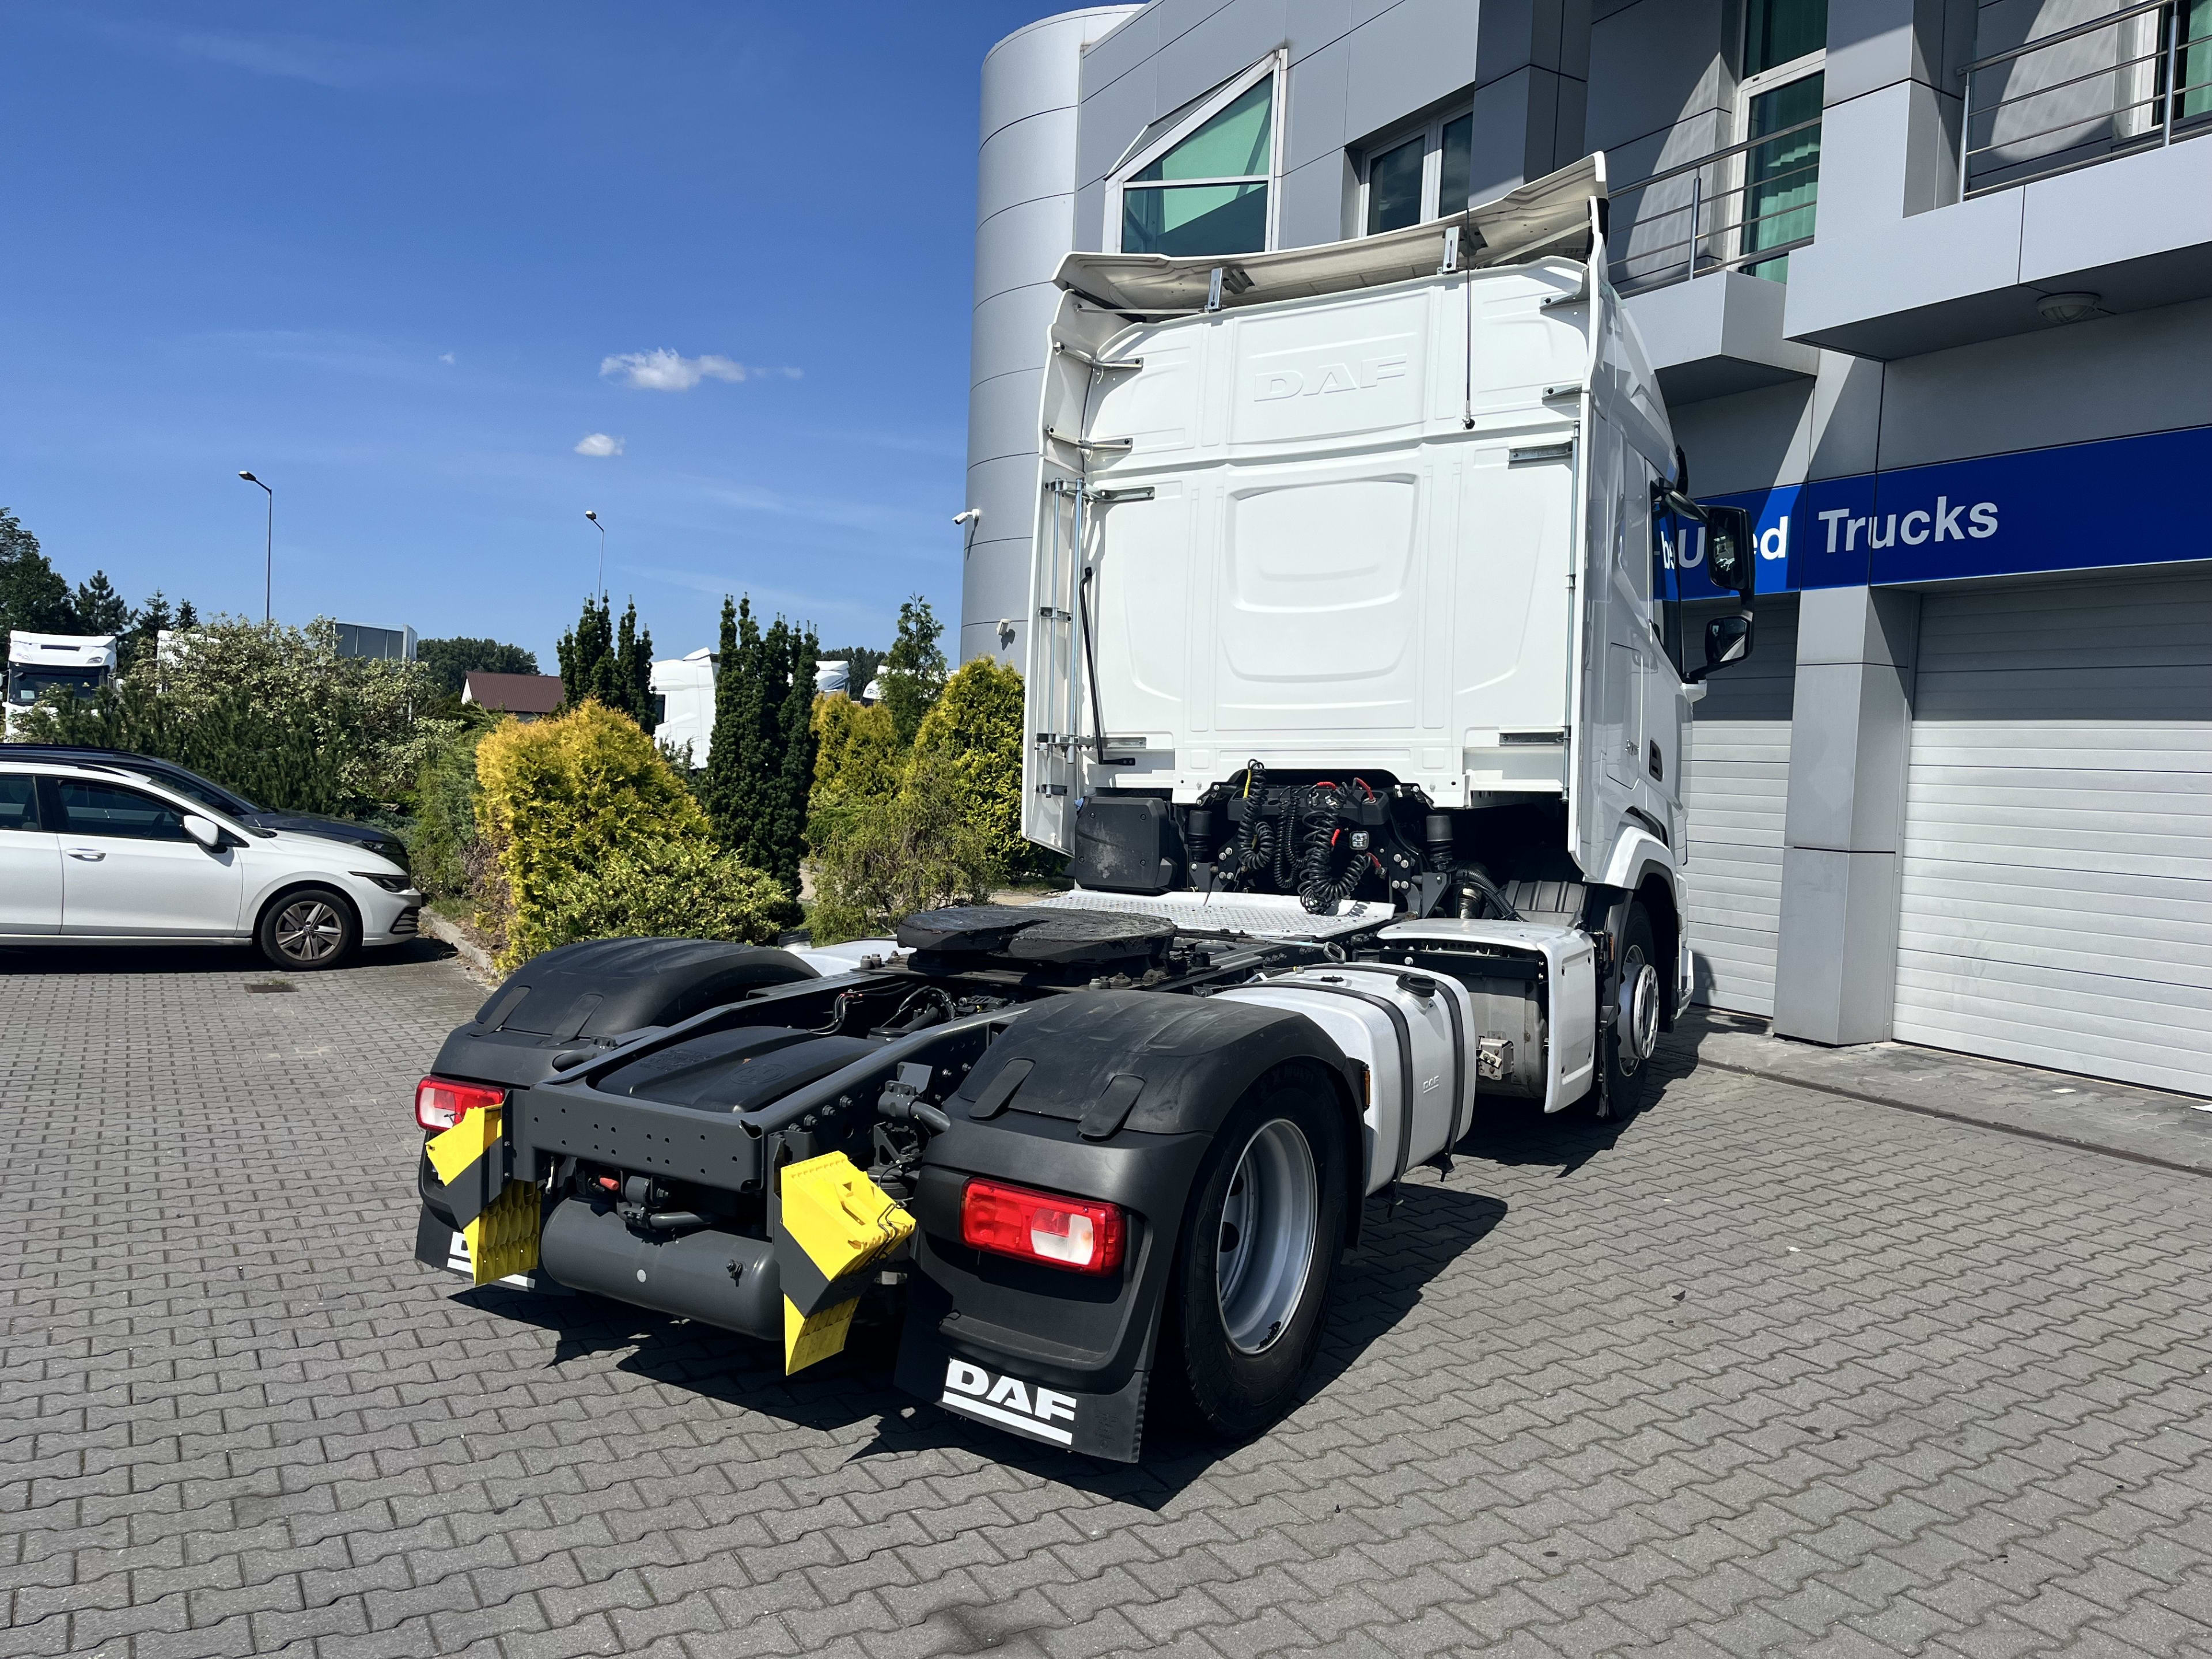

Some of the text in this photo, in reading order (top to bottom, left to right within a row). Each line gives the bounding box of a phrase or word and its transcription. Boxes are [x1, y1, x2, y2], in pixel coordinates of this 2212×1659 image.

[1254, 354, 1407, 402] DAF
[1678, 516, 1789, 569] Ud
[1818, 496, 1998, 554] Trucks
[945, 1358, 1077, 1421] DAF
